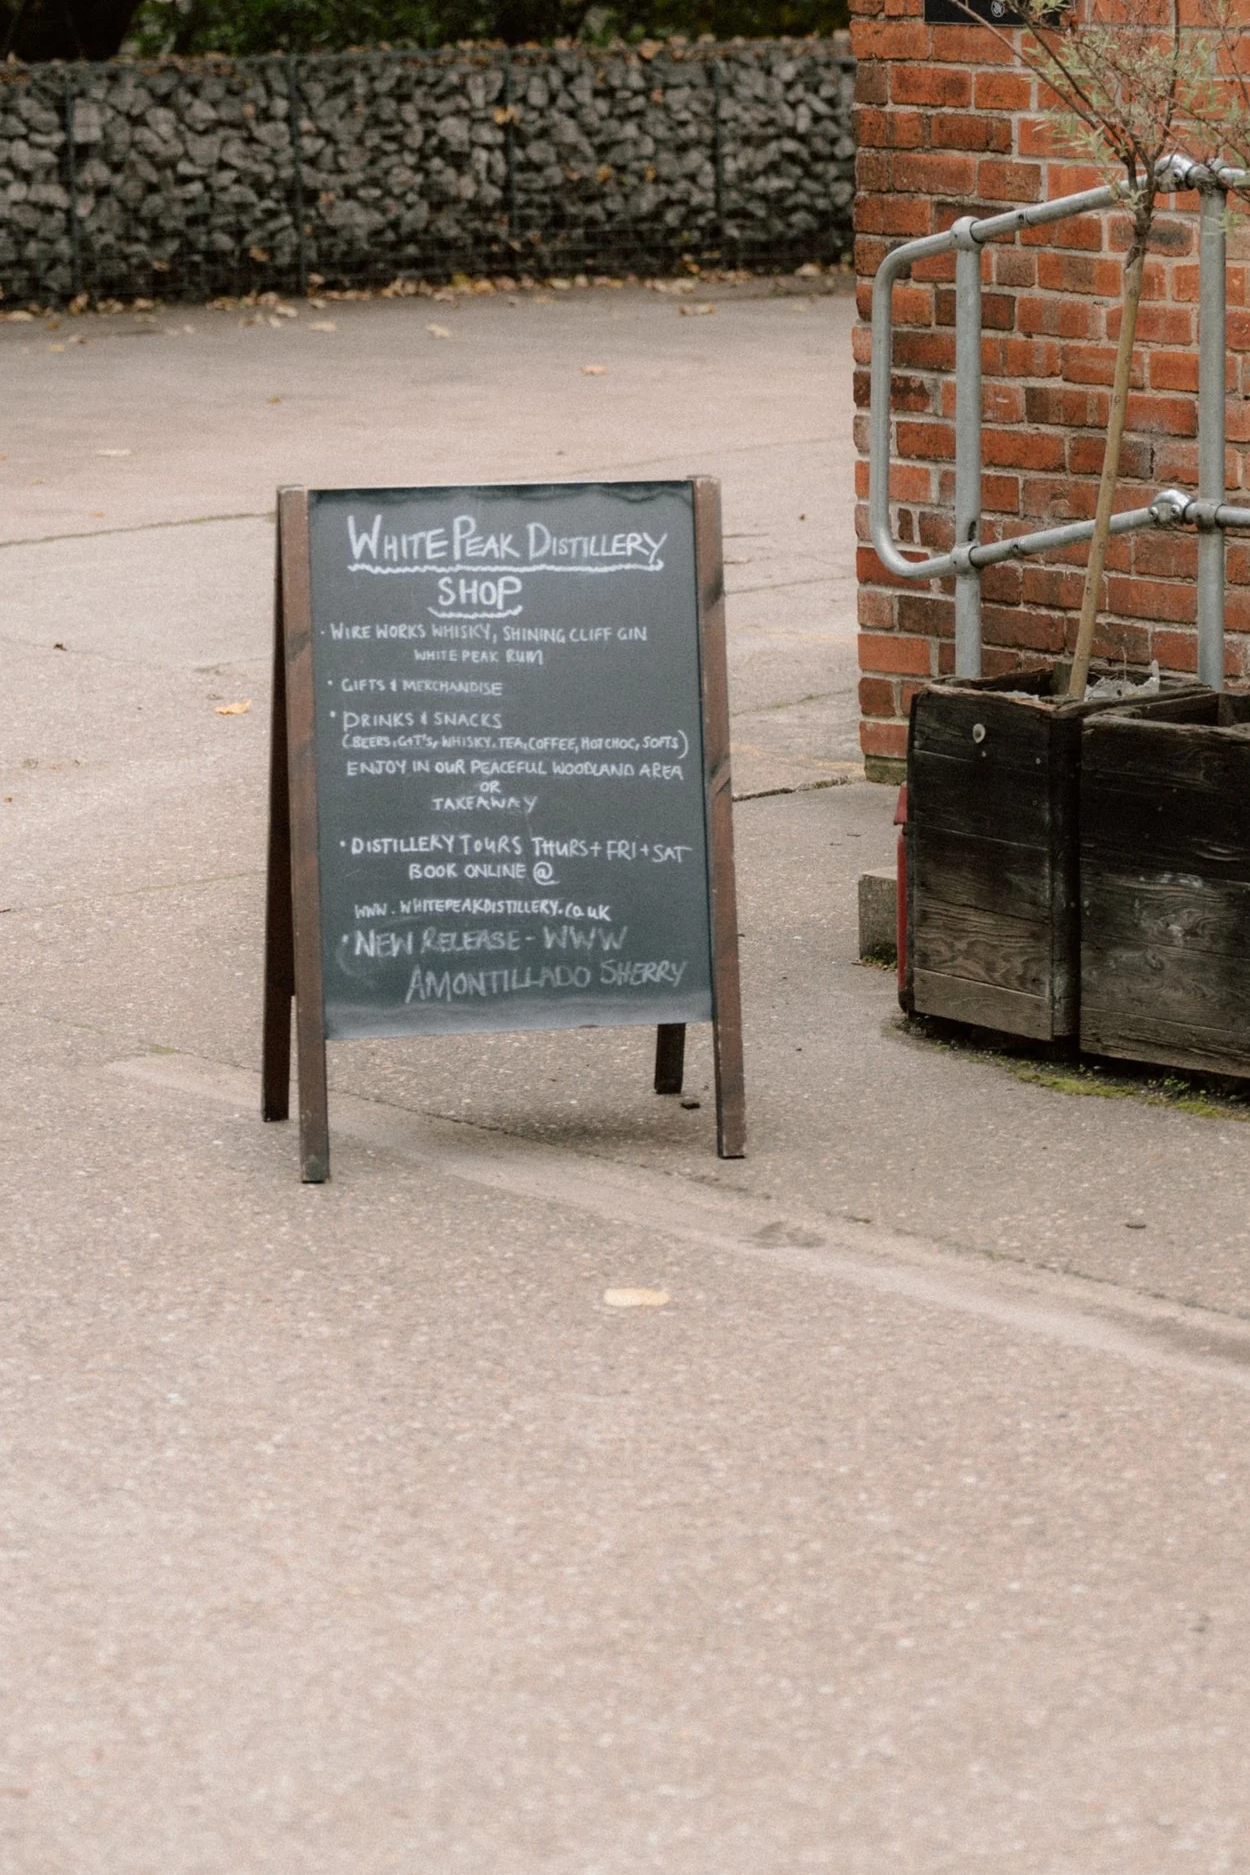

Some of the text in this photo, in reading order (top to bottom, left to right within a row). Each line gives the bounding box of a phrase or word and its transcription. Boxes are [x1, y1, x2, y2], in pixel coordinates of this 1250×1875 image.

[438, 575, 522, 610] SHOP
[432, 623, 497, 644] WHISKY,
[503, 625, 566, 644] SHINING
[569, 627, 612, 642] CLIFF
[617, 626, 648, 641] GIN
[414, 649, 544, 665] WHITE PEAK RUM
[341, 678, 386, 692] GIFTS
[402, 679, 504, 696] MERCHANDISE
[343, 710, 415, 732] DRINKS
[433, 712, 502, 729] SNACKS
[347, 759, 684, 781] ENJOY IN OUR PEACEFUL WOODLAND AREA
[479, 780, 502, 793] OR
[432, 795, 538, 813] TAKEAWAY
[351, 834, 455, 855] DISTILLERY
[460, 834, 523, 855] TOURS
[607, 840, 636, 860] FRI
[652, 845, 693, 863] SAT
[409, 861, 560, 885] BOOK ONLINE @
[354, 929, 413, 957] NEW
[421, 926, 521, 954] RELEASE
[543, 925, 628, 951] WWW
[405, 959, 688, 1003] AMONTILLADO SHERRY
